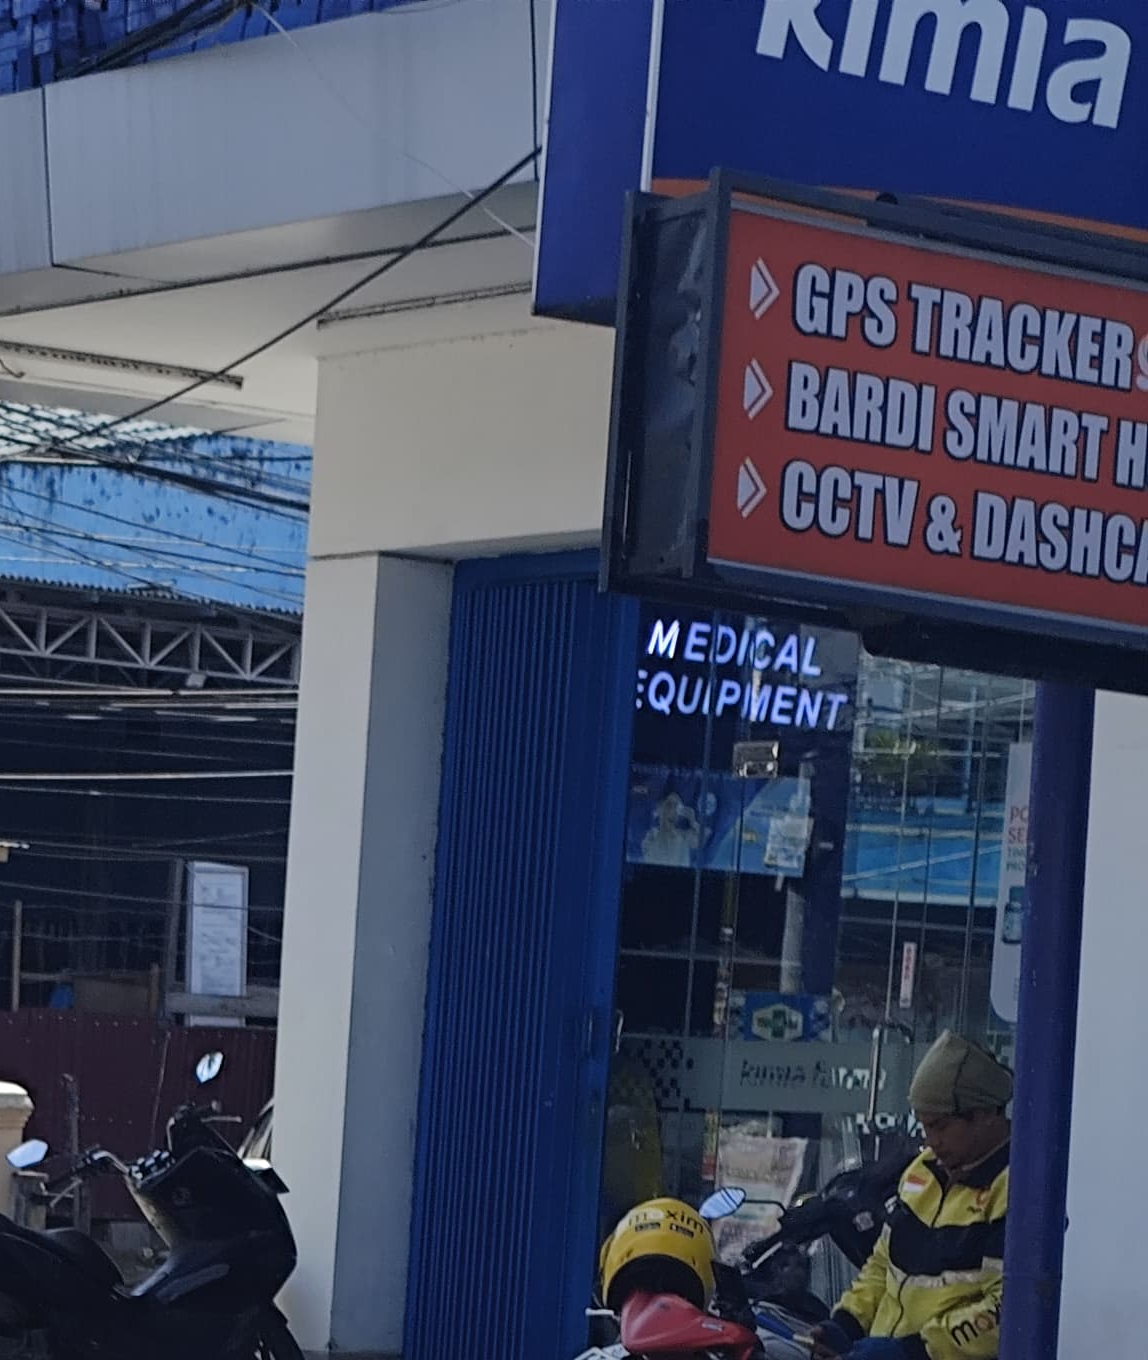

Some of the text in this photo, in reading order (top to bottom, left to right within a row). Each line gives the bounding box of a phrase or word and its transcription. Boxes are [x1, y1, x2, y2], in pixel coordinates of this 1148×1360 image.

[793, 262, 899, 348] GPS
[785, 361, 937, 453] BARDI
[945, 389, 1109, 483] SMART
[780, 458, 920, 547] CCTV
[924, 494, 963, 556] &
[647, 619, 822, 676] MEDICAL
[627, 1208, 705, 1236] mxim
